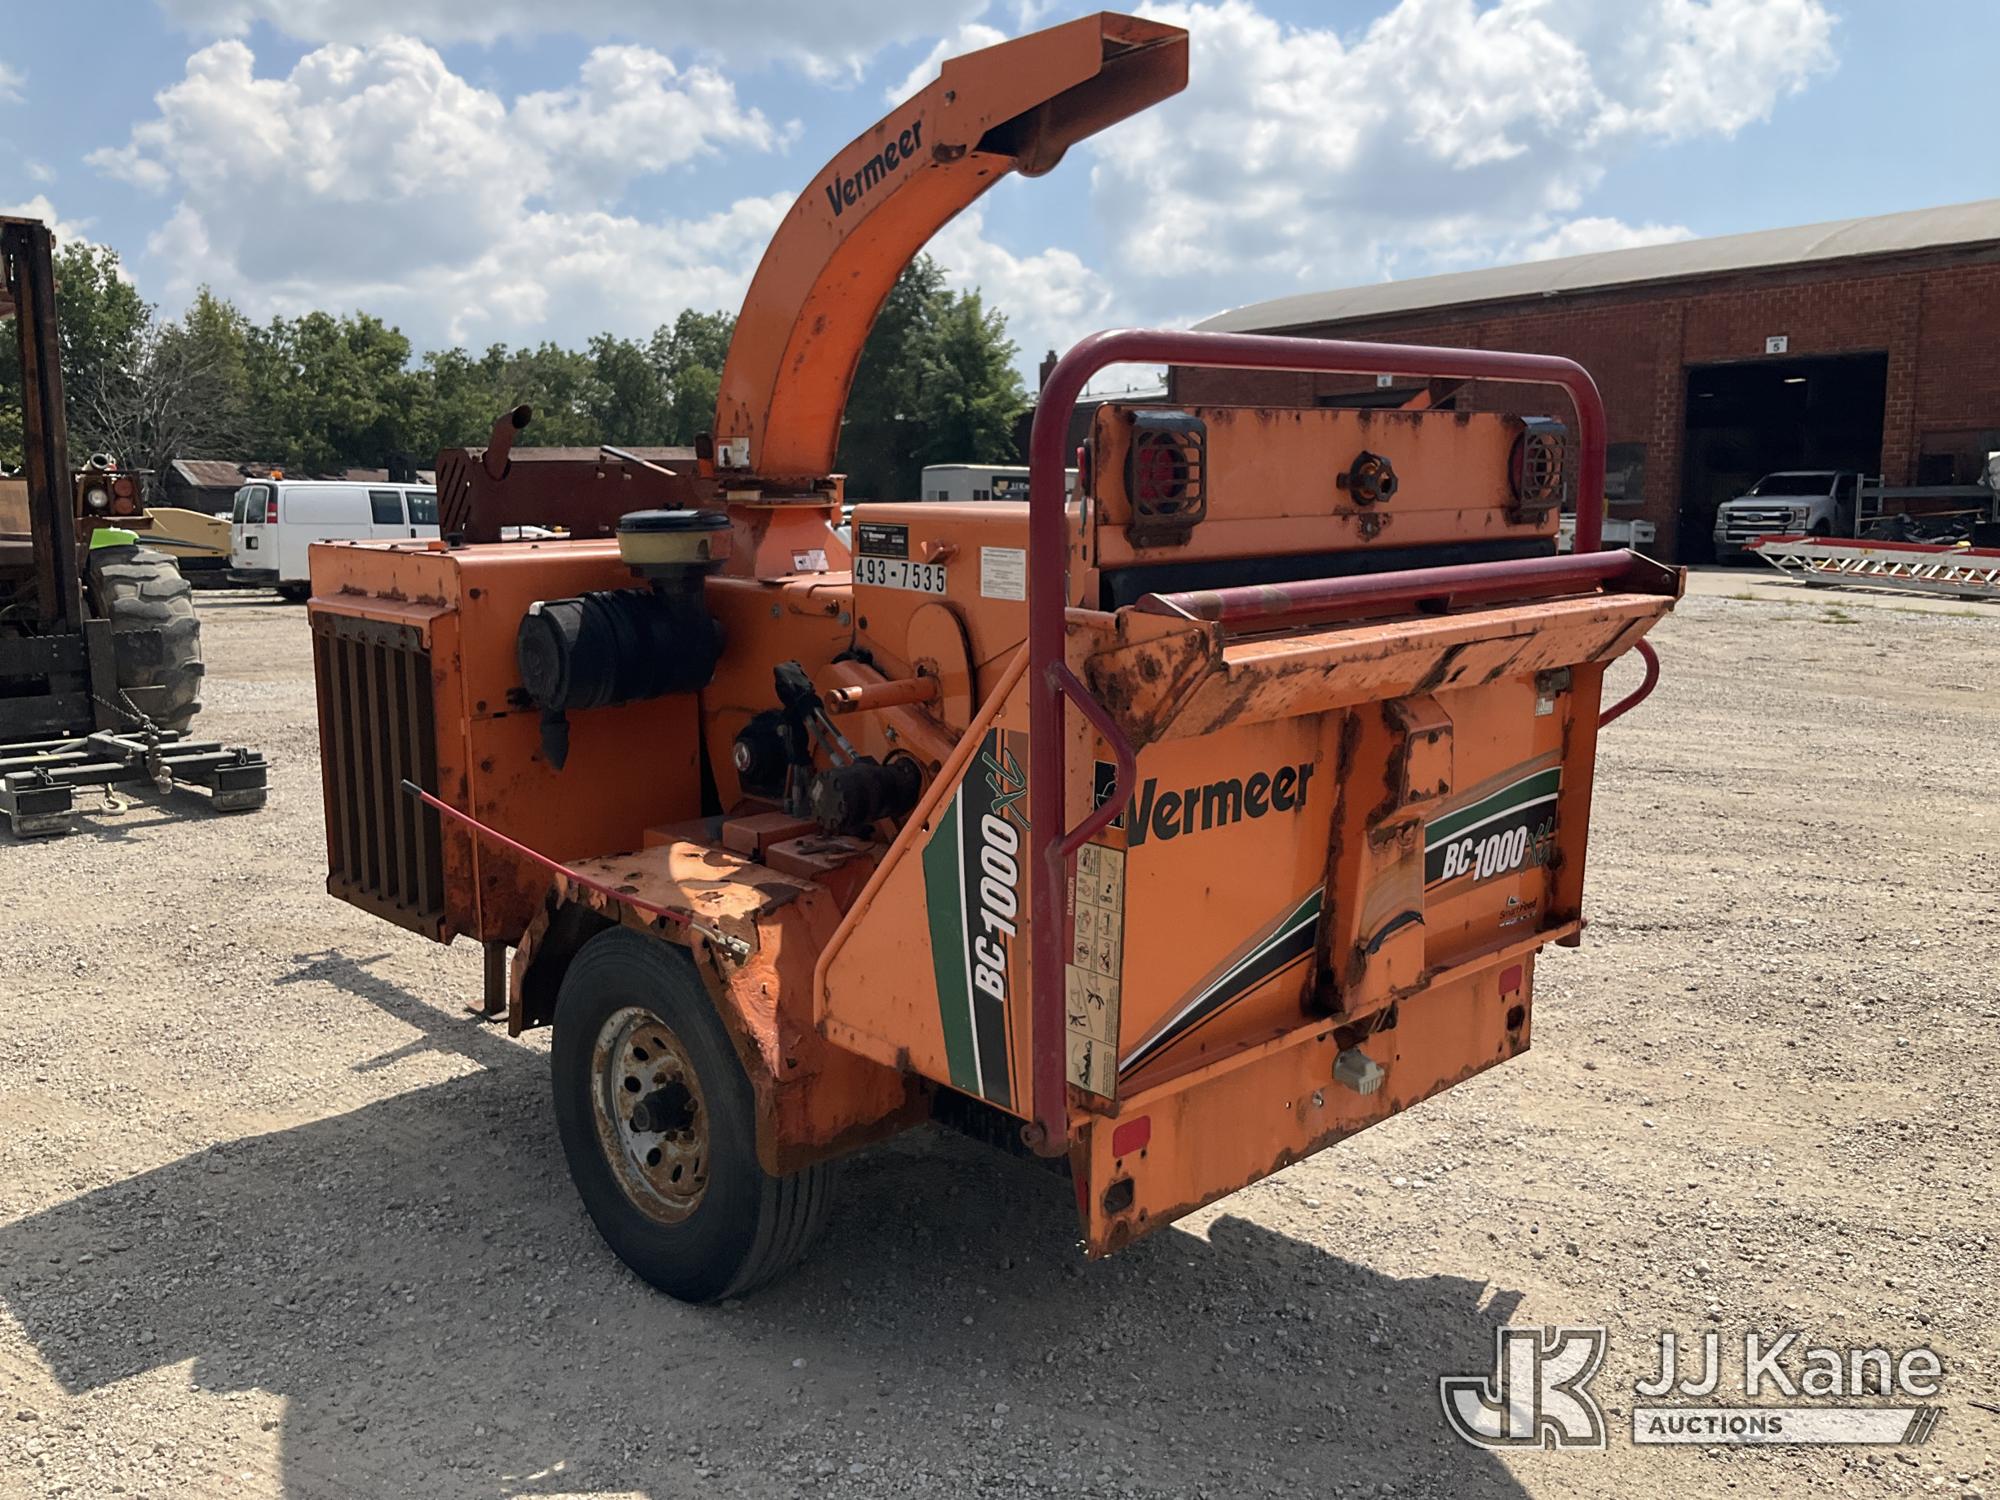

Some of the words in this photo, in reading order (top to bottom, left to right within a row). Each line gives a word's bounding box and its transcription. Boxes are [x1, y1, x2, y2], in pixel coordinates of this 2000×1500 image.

[825, 119, 922, 217] Vermeer
[1773, 343, 1780, 352] 5
[856, 559, 945, 593] 493-7535
[1128, 762, 1314, 848] Vermeer
[1067, 876, 1075, 916] DANGER
